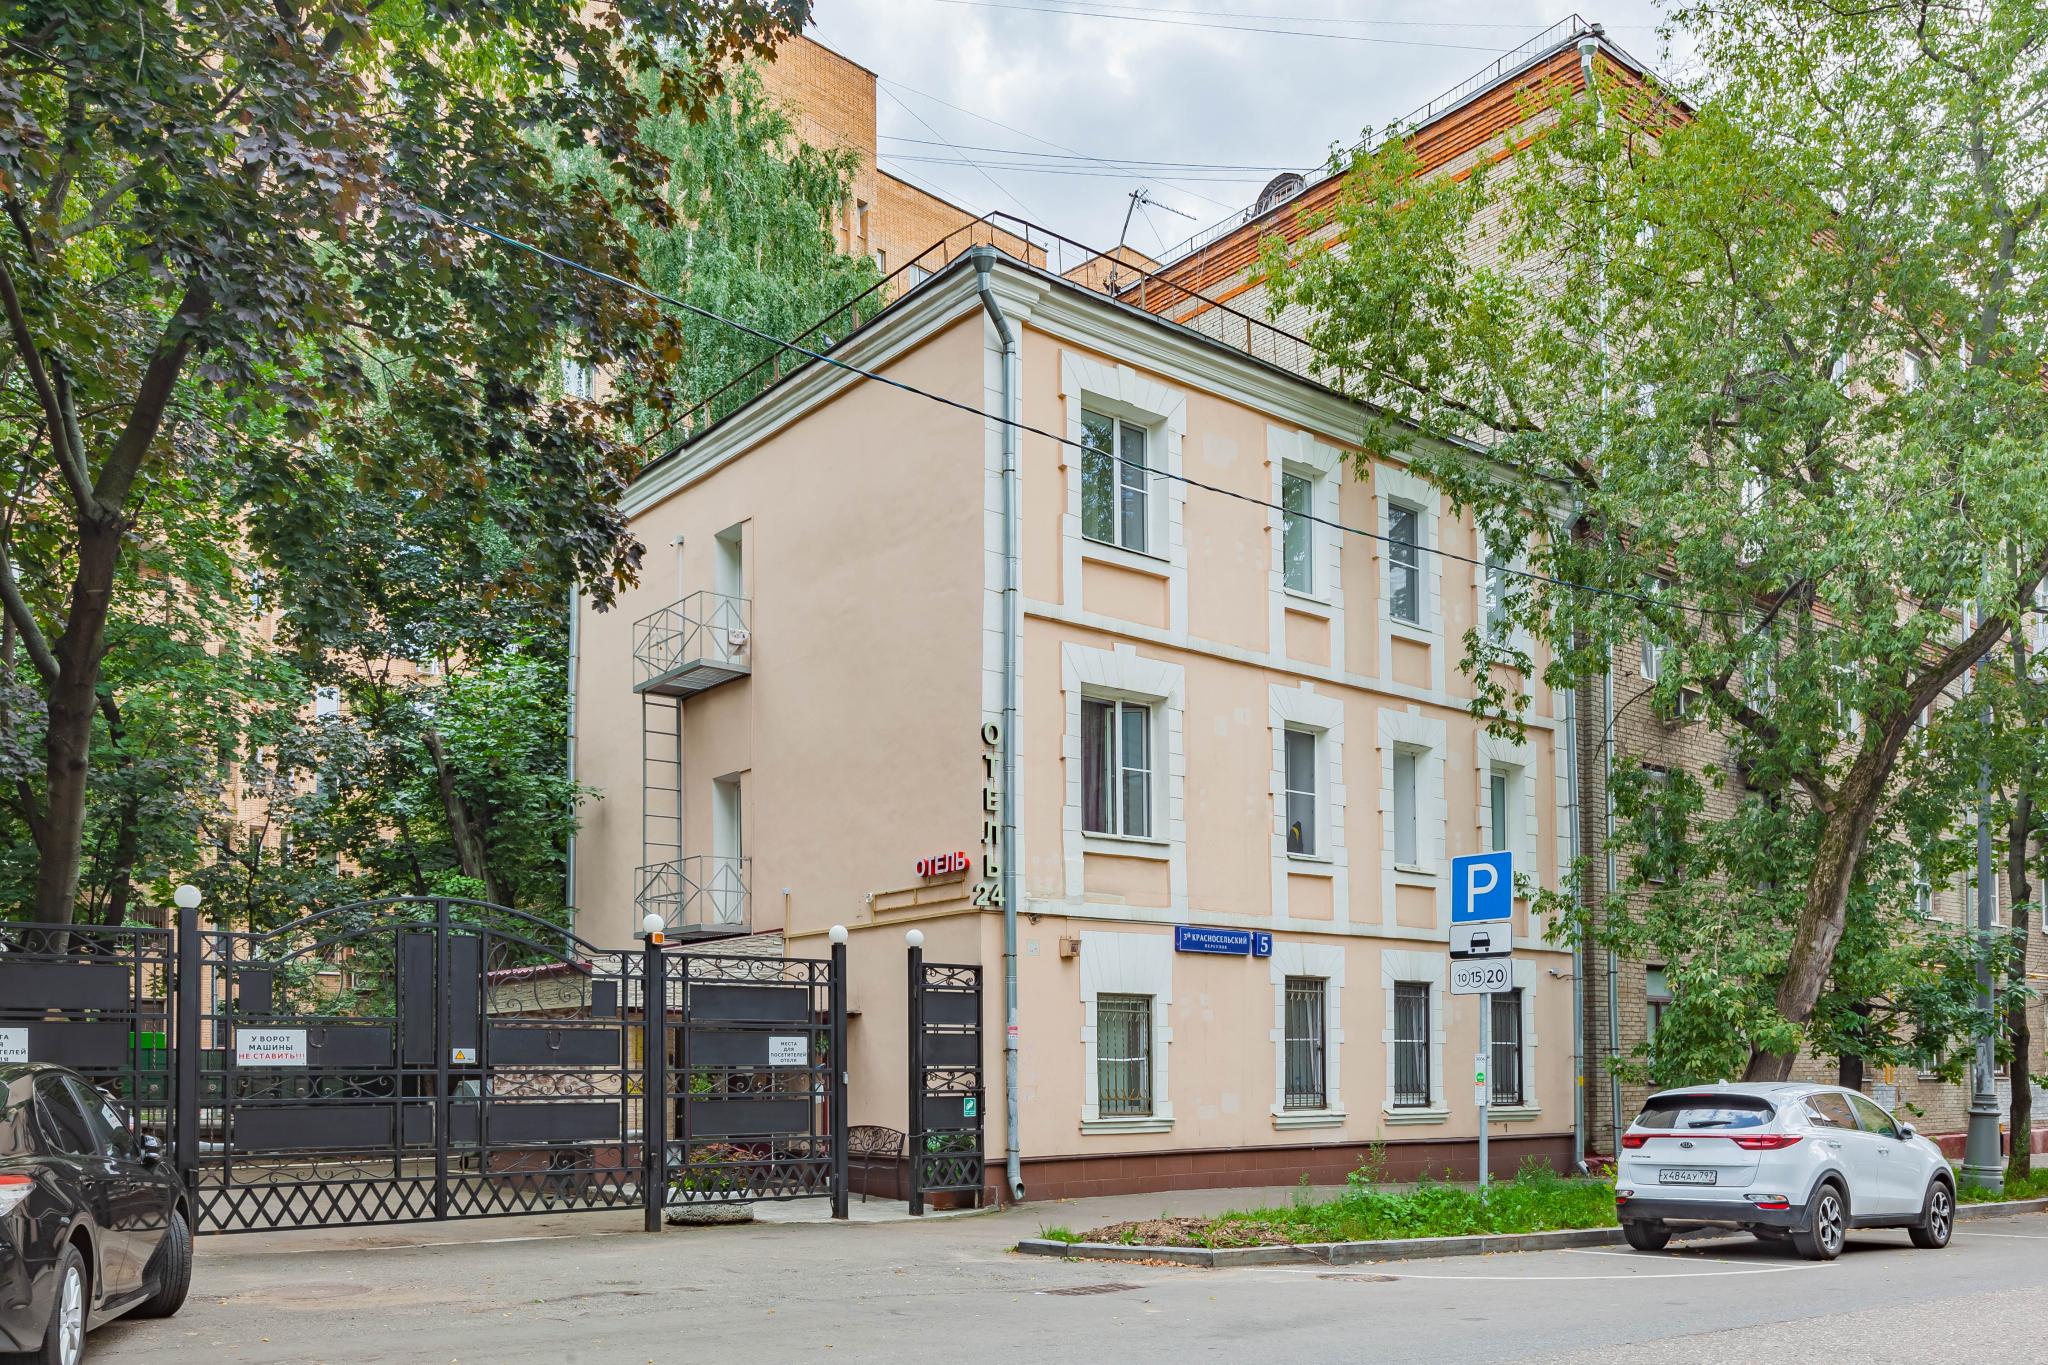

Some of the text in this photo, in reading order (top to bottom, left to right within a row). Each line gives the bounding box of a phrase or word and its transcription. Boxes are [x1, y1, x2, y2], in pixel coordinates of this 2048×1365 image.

[973, 721, 1007, 907] ОТЕЛЬ 24
[912, 851, 970, 878] ОТЕЛЬ
[1467, 863, 1498, 913] P
[1192, 934, 1248, 945] КРАСНОСЕЛЬСКИЙ
[1260, 936, 1269, 953] 5
[1457, 969, 1504, 984] 10 15 20
[1699, 1171, 1714, 1180] 797
